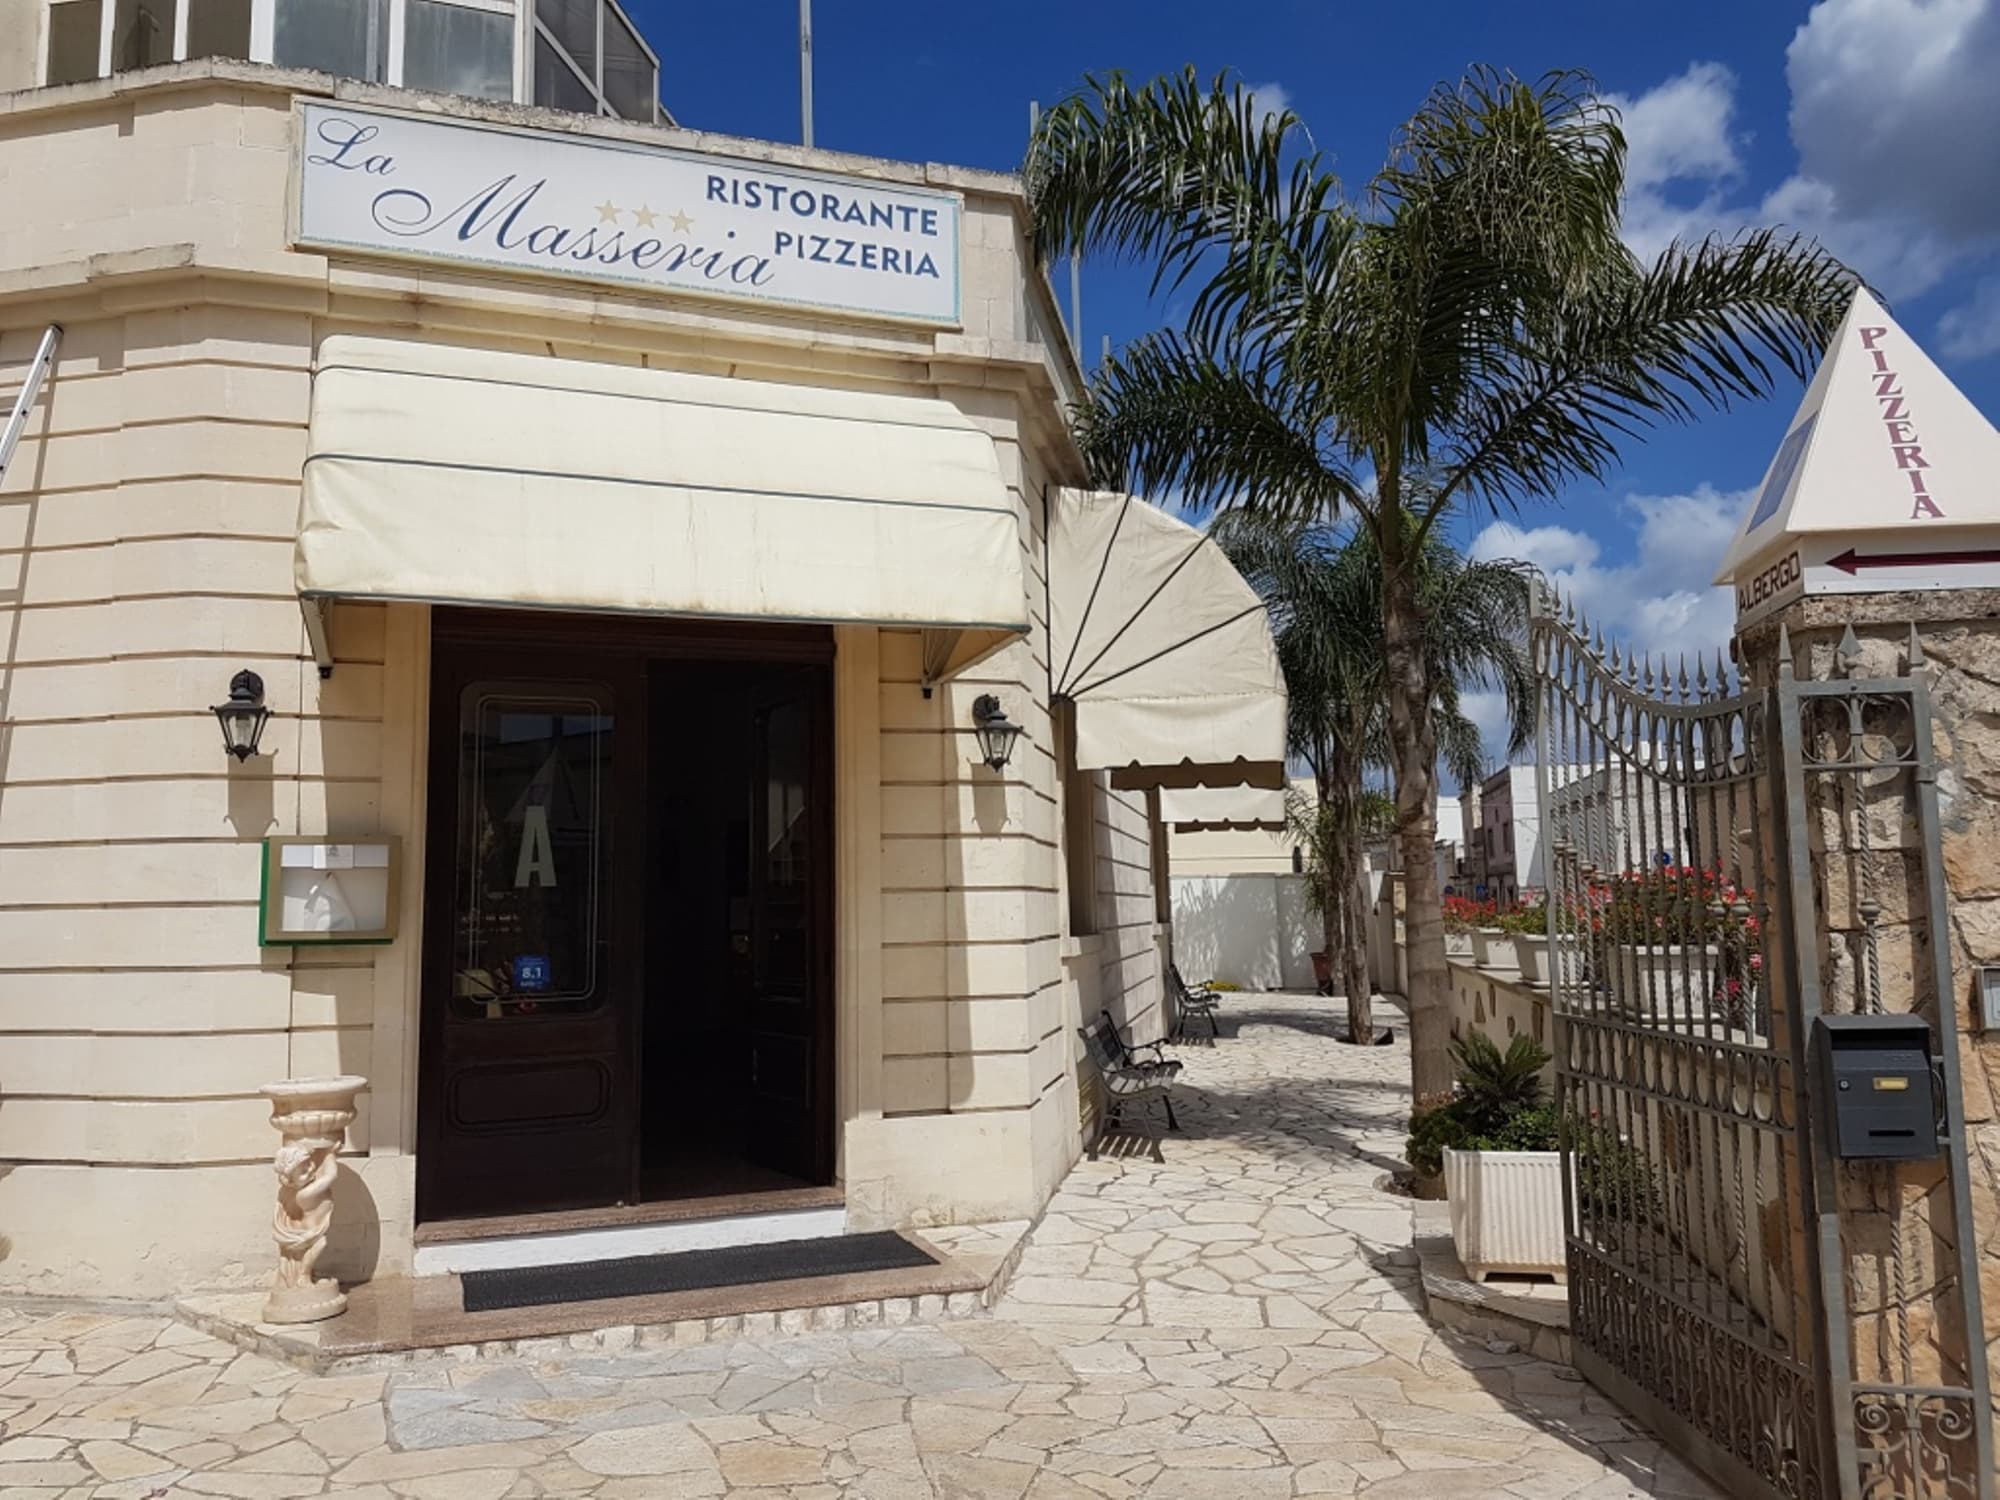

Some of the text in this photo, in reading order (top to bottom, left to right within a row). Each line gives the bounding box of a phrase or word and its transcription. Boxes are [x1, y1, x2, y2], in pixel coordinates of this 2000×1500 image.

[308, 117, 780, 287] La Masseria
[707, 175, 939, 236] RISTORANTE
[774, 231, 940, 279] PIZZERIA
[1859, 326, 1947, 519] PIZZERIA
[1738, 550, 1801, 612] ALBERGO
[521, 966, 543, 979] 8.1
